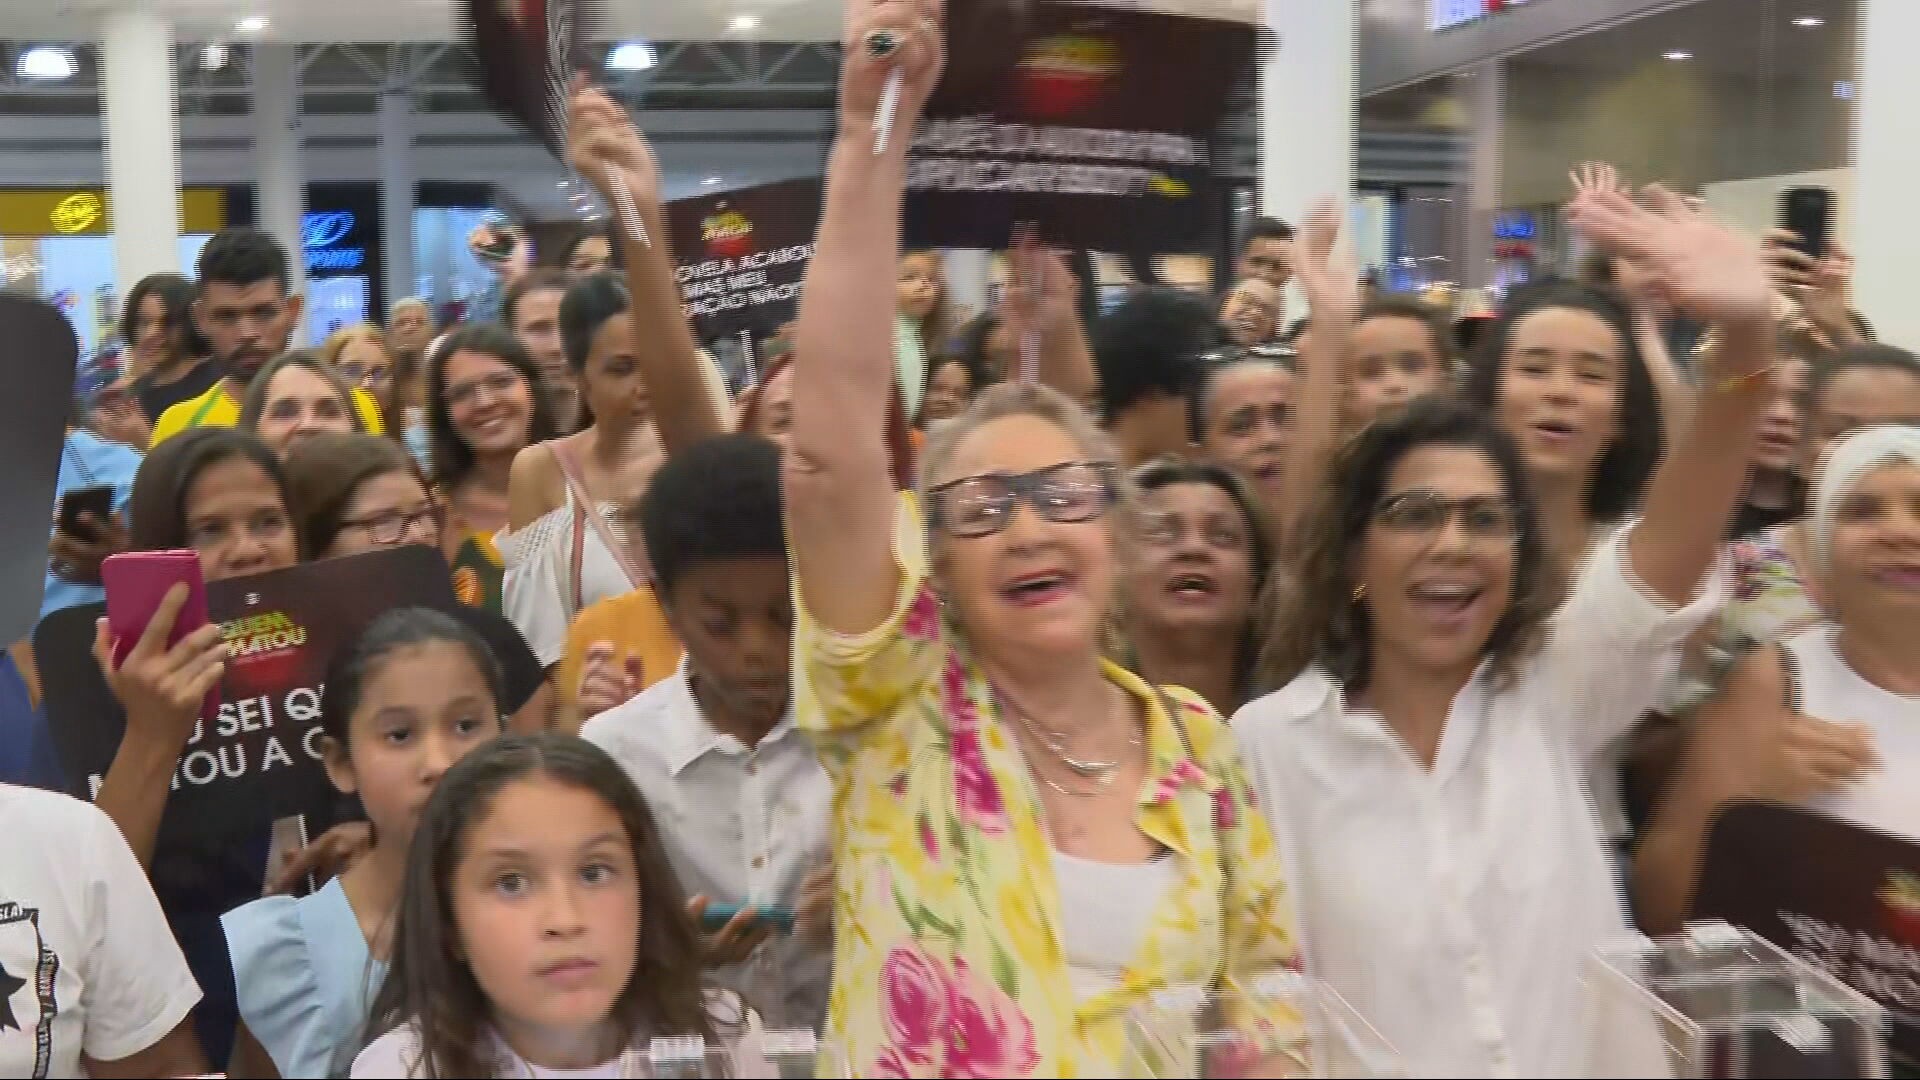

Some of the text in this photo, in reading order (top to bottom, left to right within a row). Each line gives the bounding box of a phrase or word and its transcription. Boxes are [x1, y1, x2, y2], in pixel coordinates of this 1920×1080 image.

[675, 256, 736, 283] OVELA
[682, 269, 767, 299] MAS MEU
[219, 611, 294, 639] QUEM
[215, 692, 275, 738] SEI
[284, 685, 326, 722] Q
[260, 737, 294, 772] A
[1851, 929, 1920, 974] MA
[1849, 960, 1920, 1008] NO
